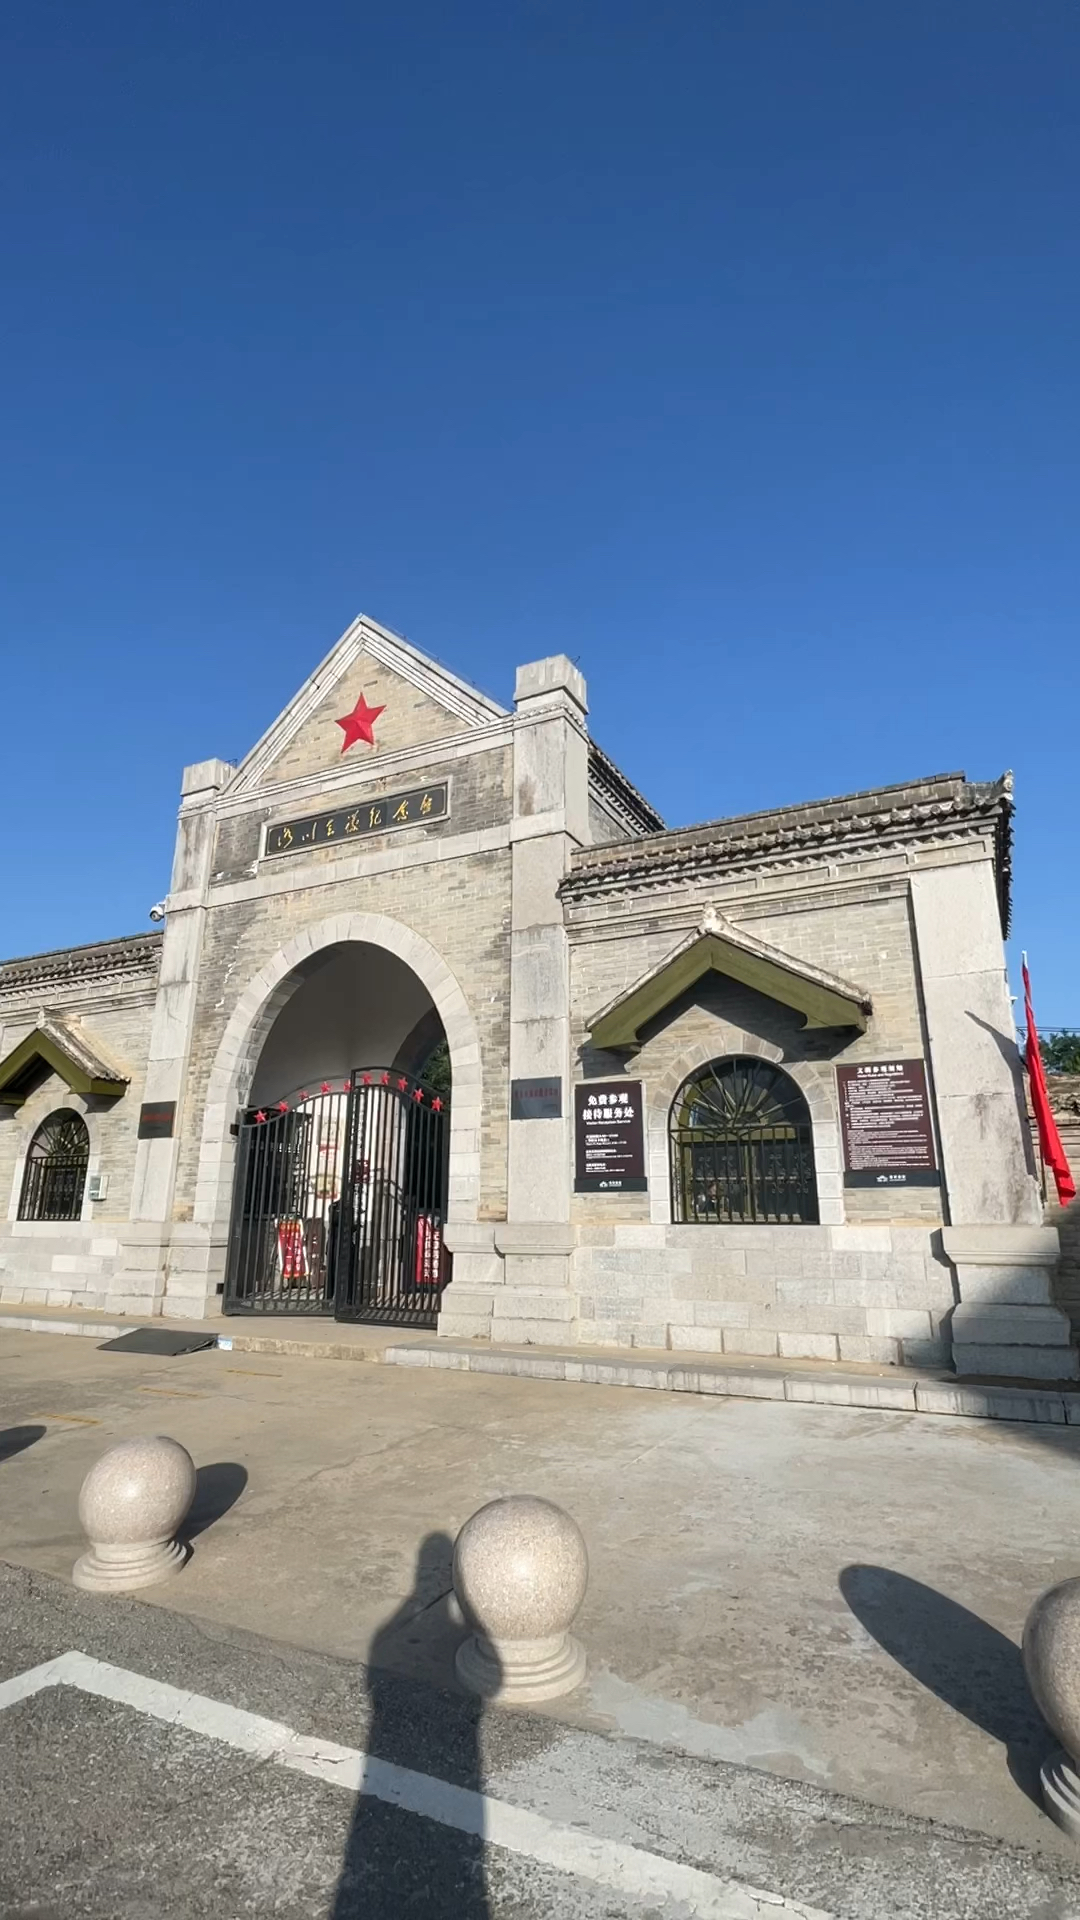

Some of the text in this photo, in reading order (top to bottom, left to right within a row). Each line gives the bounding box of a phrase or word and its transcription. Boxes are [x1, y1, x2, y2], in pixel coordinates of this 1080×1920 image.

[587, 1093, 629, 1106] 免费参观
[582, 1106, 635, 1121] 接待服务处
